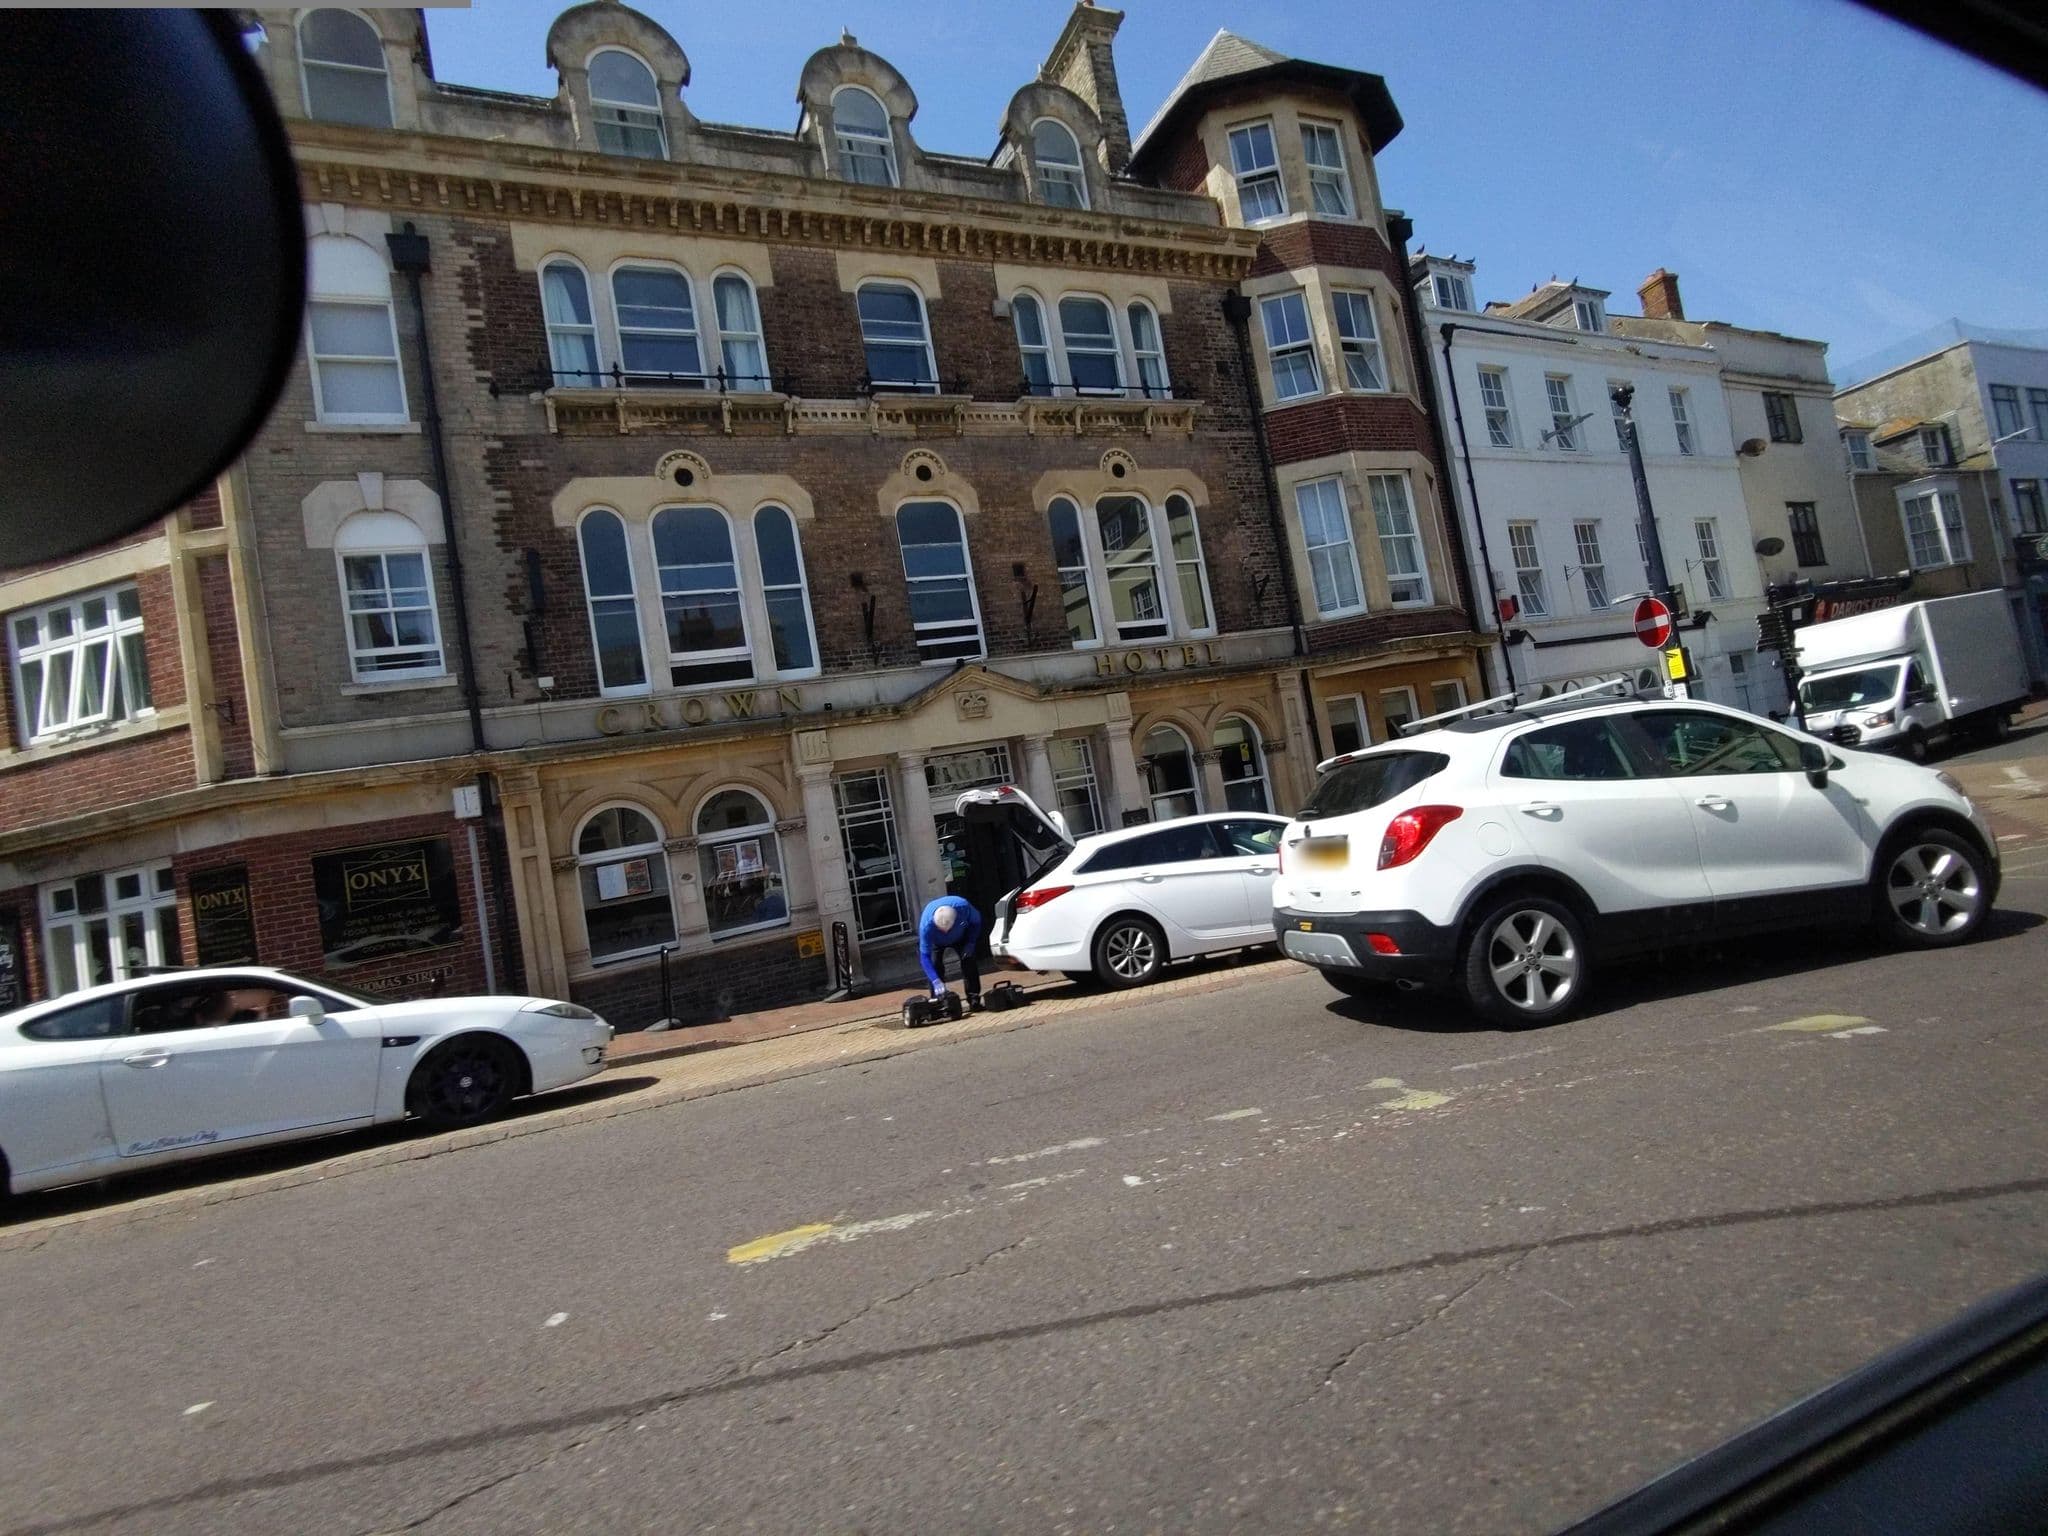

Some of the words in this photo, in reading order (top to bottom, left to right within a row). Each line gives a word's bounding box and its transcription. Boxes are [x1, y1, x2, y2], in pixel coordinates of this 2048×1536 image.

[1093, 640, 1224, 677] HOTEL
[596, 686, 804, 736] CROWN
[350, 864, 422, 890] ONYX
[199, 888, 243, 910] ONYX
[406, 966, 449, 985] STREET
